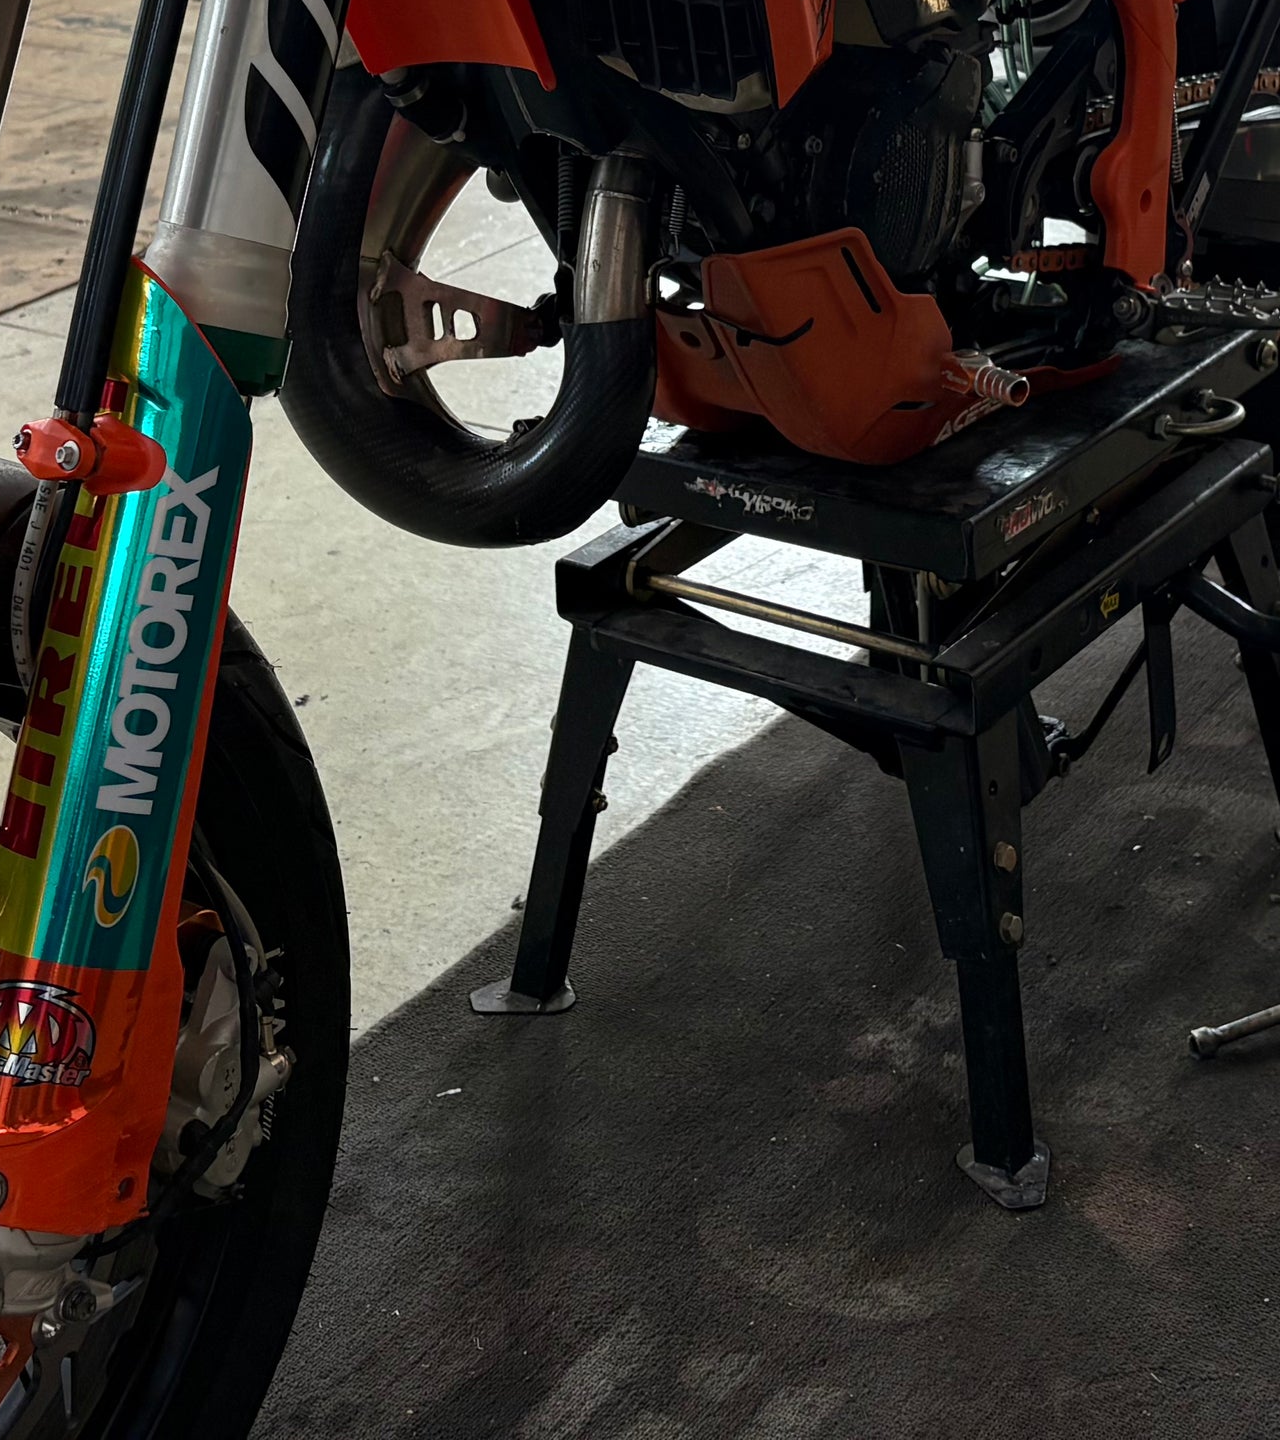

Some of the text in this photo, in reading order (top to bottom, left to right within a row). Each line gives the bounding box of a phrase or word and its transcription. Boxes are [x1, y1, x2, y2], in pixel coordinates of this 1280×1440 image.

[35, 484, 52, 514] SAE
[20, 541, 37, 572] 1401
[96, 465, 220, 816] MOTOREX
